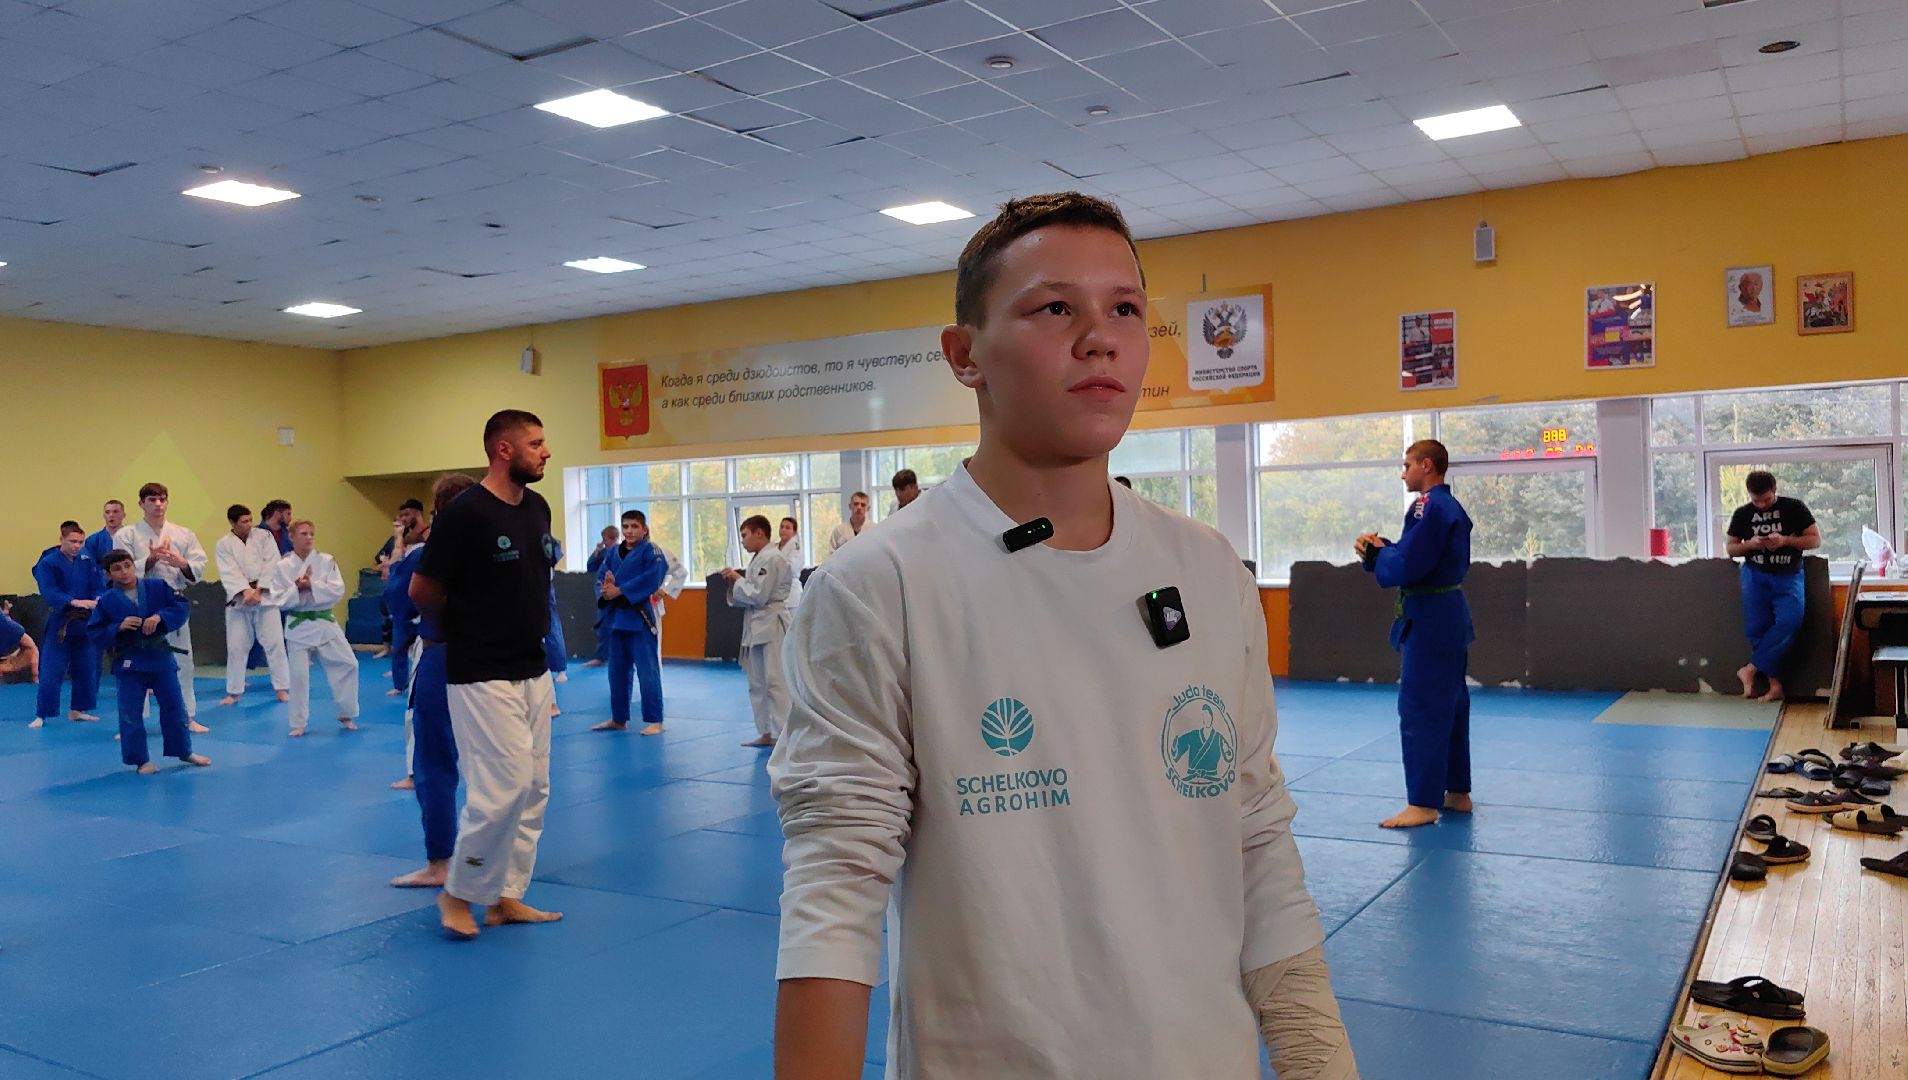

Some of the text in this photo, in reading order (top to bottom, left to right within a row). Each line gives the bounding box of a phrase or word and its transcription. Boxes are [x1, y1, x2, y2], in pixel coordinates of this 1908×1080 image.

[1148, 321, 1182, 338] зей,
[661, 374, 693, 388] Когда
[696, 374, 704, 385] я
[706, 369, 740, 385] среди
[743, 356, 821, 381] дзюдоистов,
[825, 361, 844, 373] то
[846, 359, 855, 371] я
[857, 352, 922, 372] чувствую
[662, 380, 876, 409] а как среди близких родственников.
[1751, 510, 1780, 522] ARE
[1751, 522, 1782, 535] YOU
[1173, 684, 1226, 713] Judo team
[956, 768, 1068, 795] SCHELKOVO
[1165, 769, 1236, 799] SCHELKOVO
[959, 788, 1071, 816] AGROHIM
